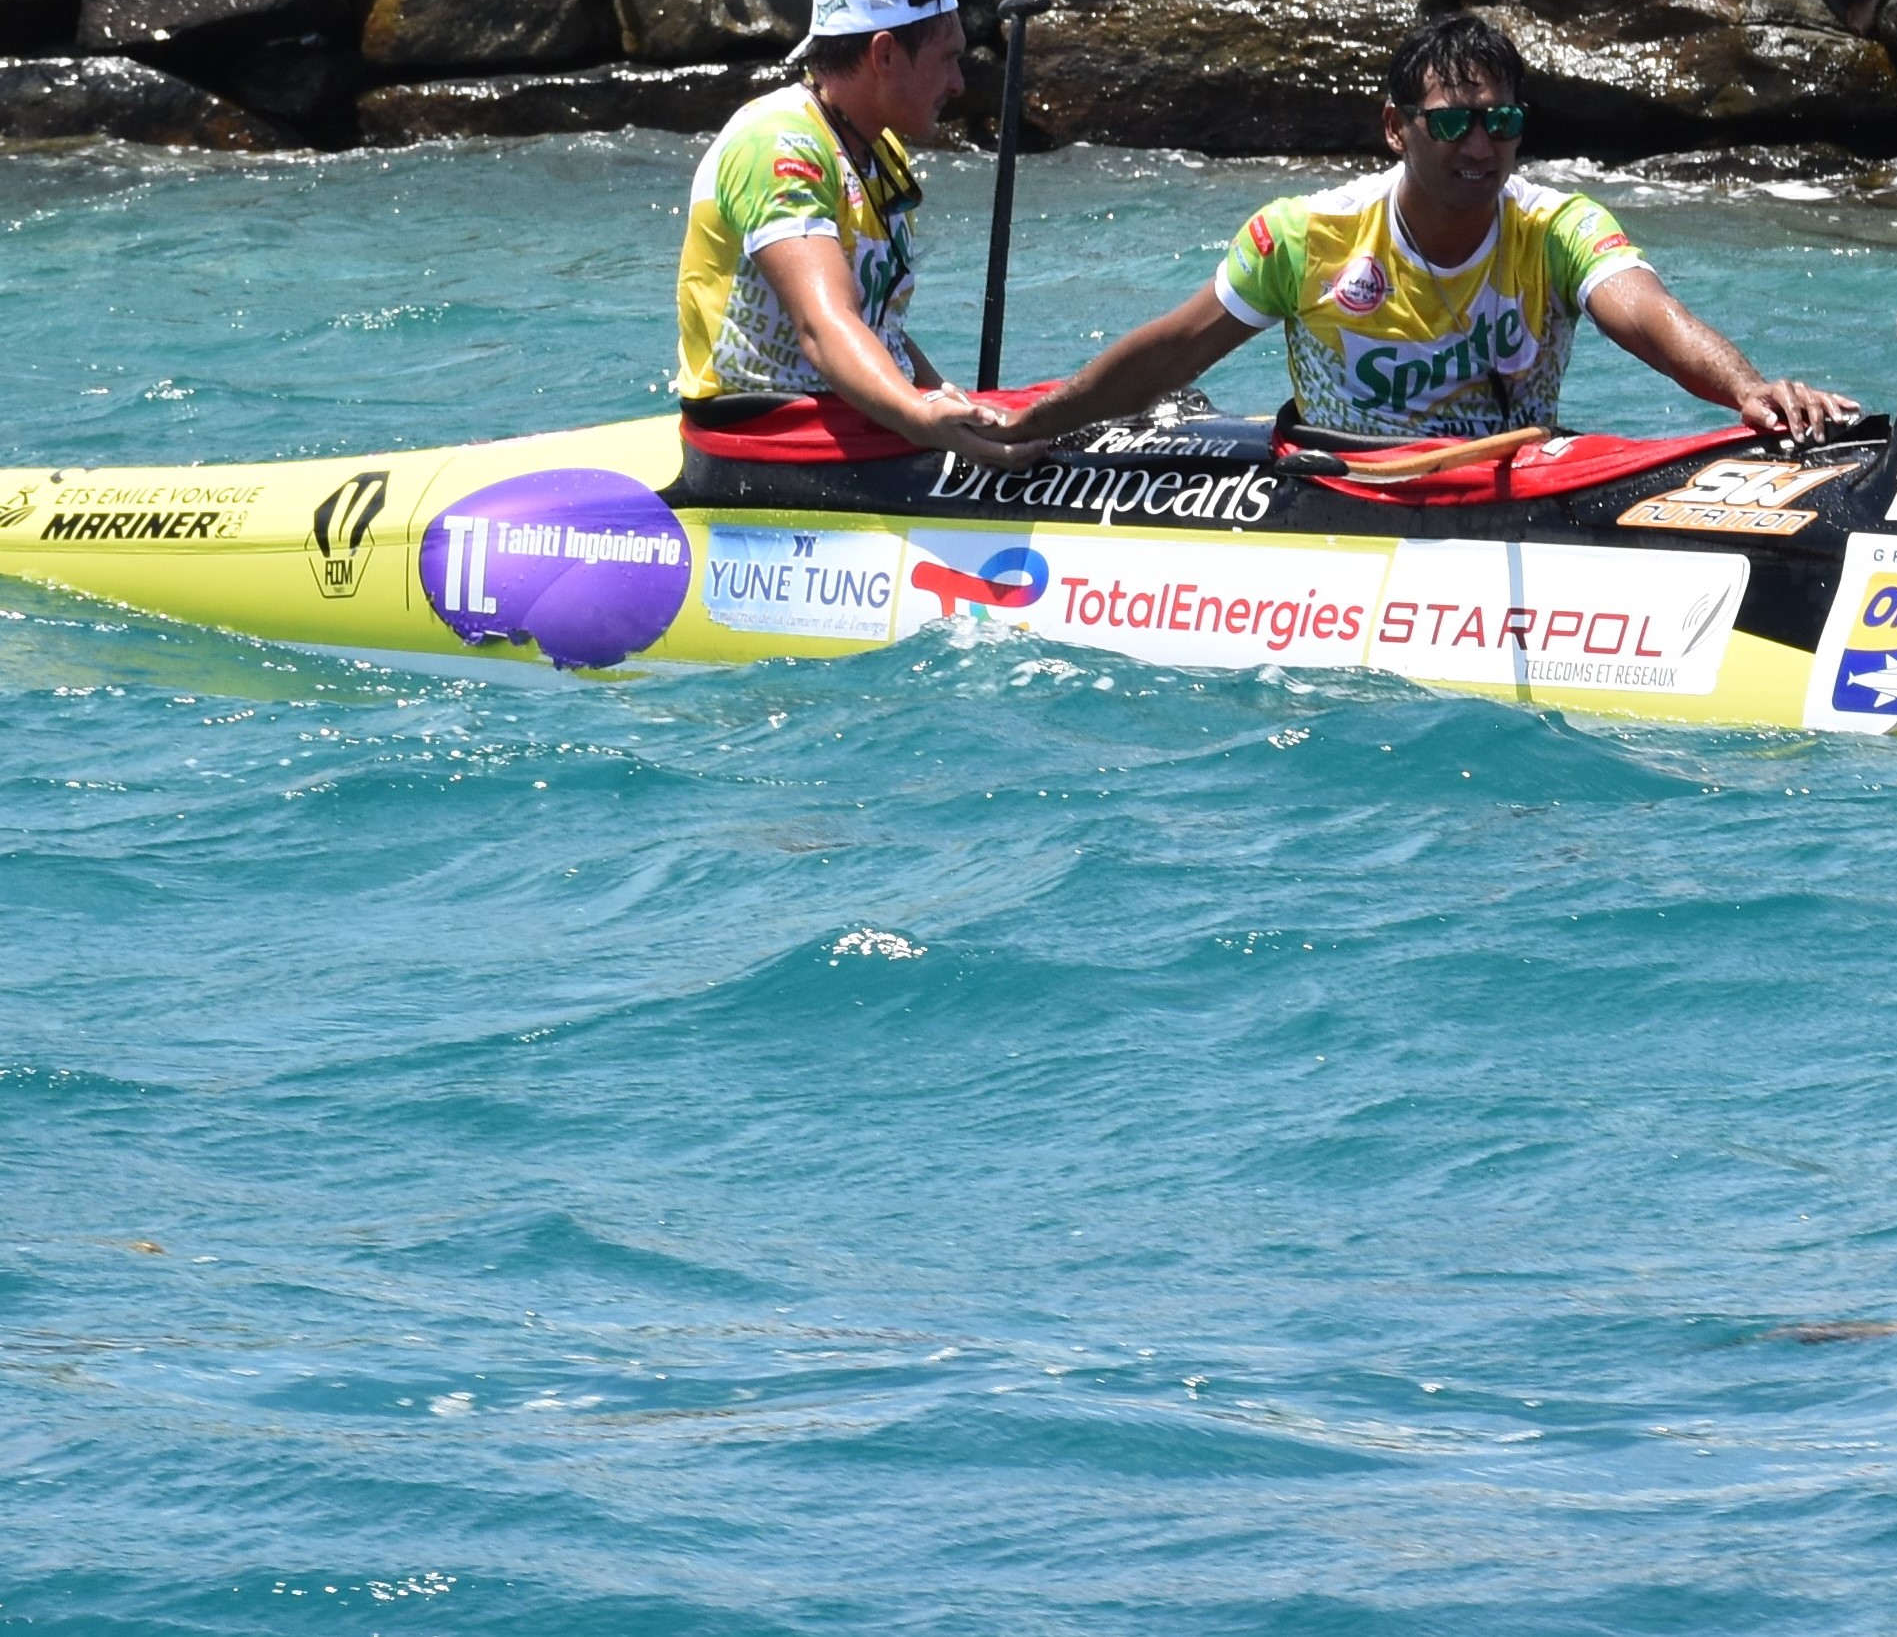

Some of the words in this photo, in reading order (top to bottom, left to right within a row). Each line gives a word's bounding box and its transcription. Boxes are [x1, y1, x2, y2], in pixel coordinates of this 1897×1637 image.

[1352, 308, 1526, 413] Sprite
[1083, 427, 1239, 458] Fakarava
[55, 486, 93, 506] ETS
[99, 486, 166, 506] EMILE
[171, 485, 266, 505] VONGUE
[927, 450, 1278, 526] Dreampearls
[39, 511, 220, 541] MARINER
[1623, 505, 1817, 533] NUTRITION
[497, 521, 561, 558] Tahiti
[563, 524, 682, 566] Ingénierie
[710, 561, 794, 602] YUNE
[804, 567, 892, 609] TUNG
[1060, 575, 1364, 653] TotalEnergies
[1379, 602, 1664, 658] STARPOL
[1524, 659, 1594, 684] TELECOMS
[1596, 662, 1612, 684] ET
[1613, 664, 1678, 688] RESEAUX
